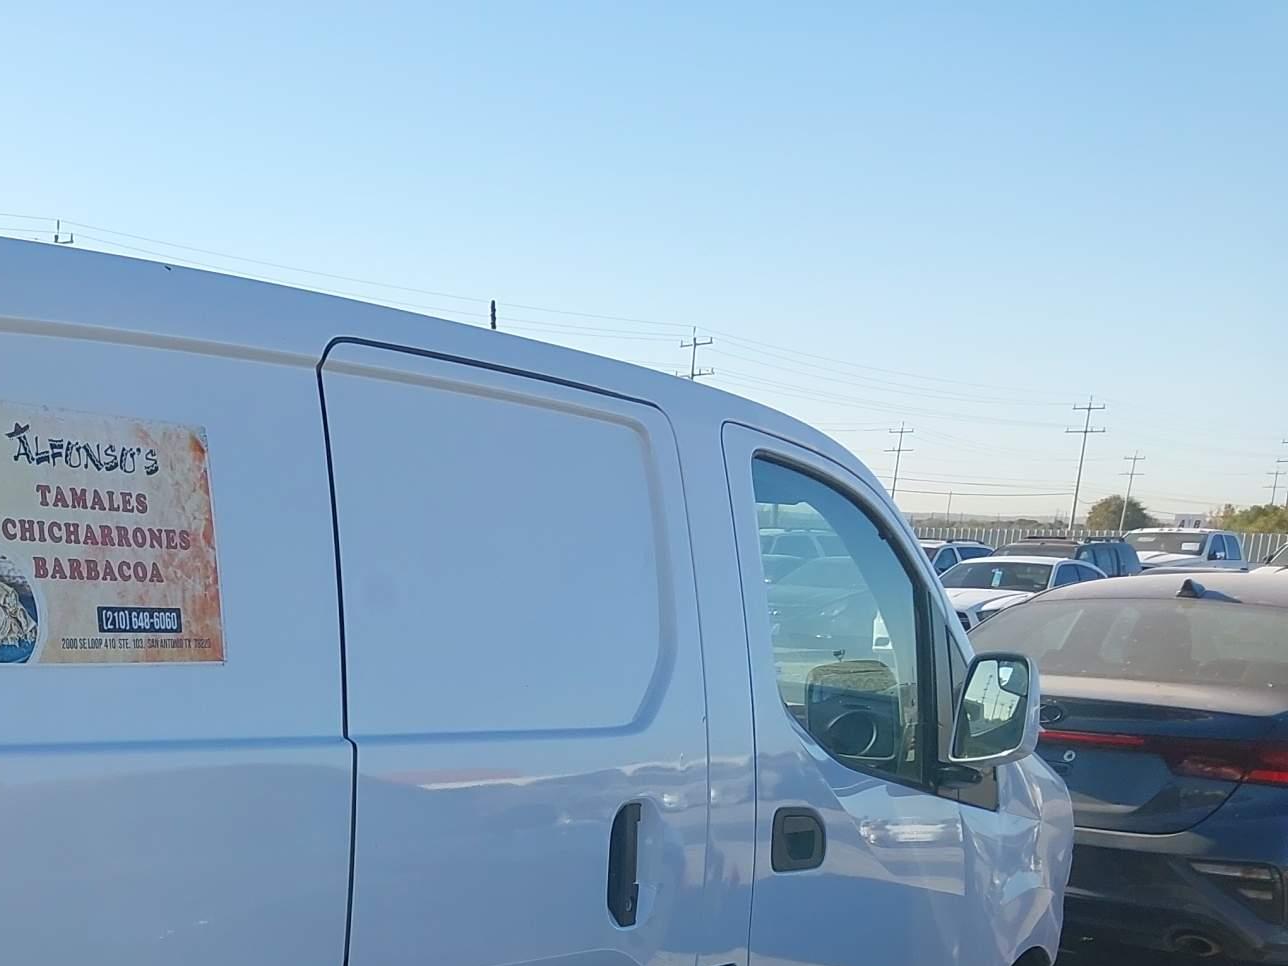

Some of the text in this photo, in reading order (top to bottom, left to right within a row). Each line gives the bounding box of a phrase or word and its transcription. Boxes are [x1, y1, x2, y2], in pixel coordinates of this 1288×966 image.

[9, 427, 160, 476] ALFONSO'S
[35, 484, 149, 514] TAMALES
[1, 518, 191, 550] CHICHARRONES
[32, 556, 165, 583] BARBACOA
[102, 610, 178, 630] (210) 648-6060
[88, 638, 103, 649] LOOP
[104, 638, 116, 649] 410
[147, 638, 159, 649] SAN
[185, 638, 192, 649] TX
